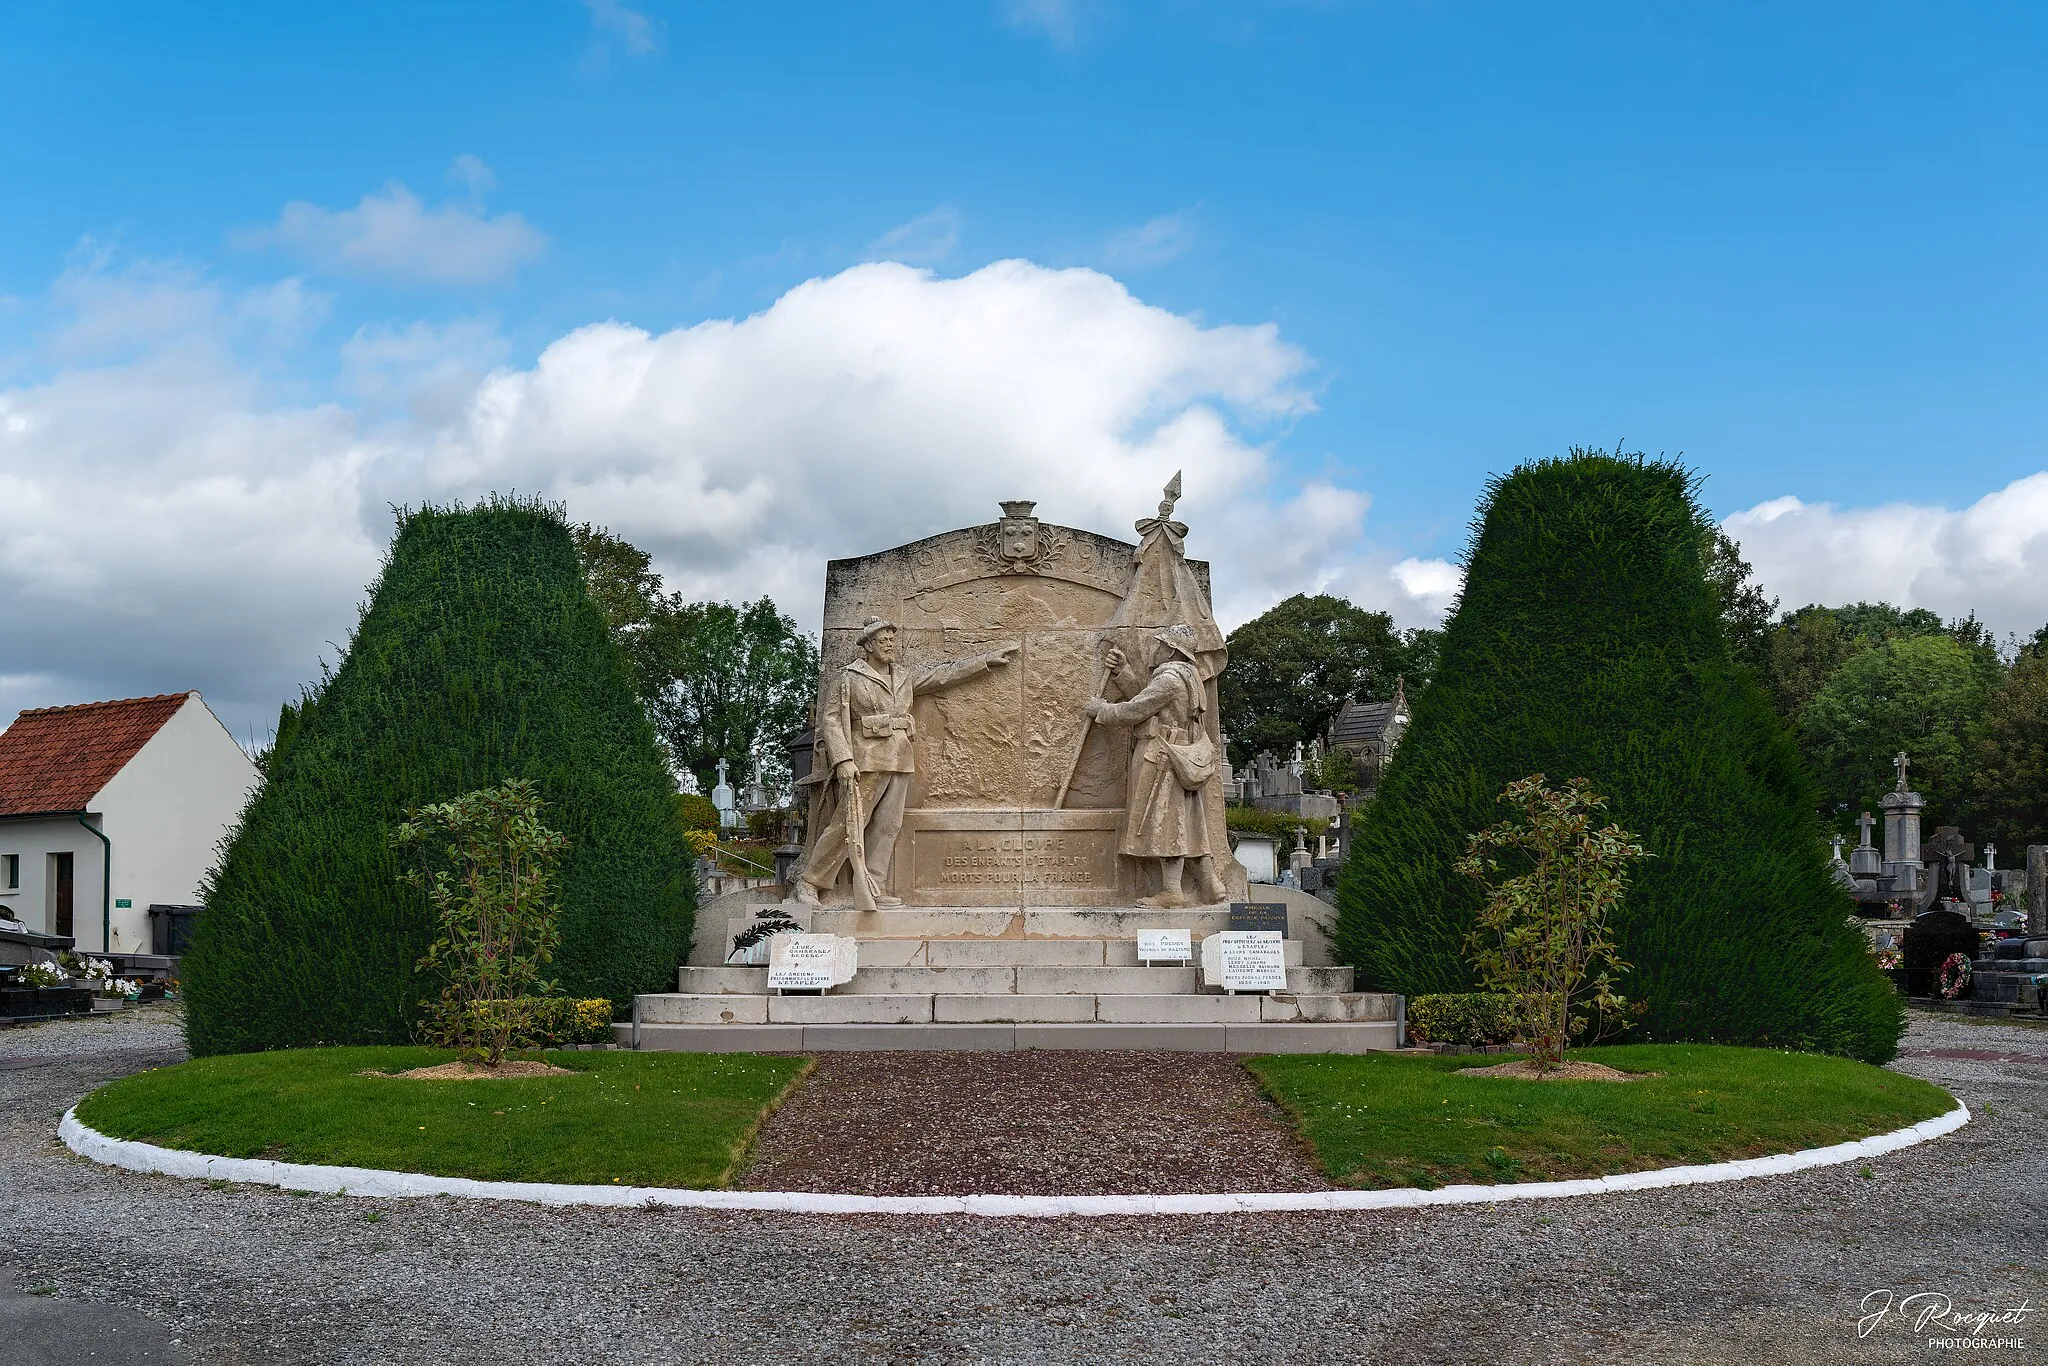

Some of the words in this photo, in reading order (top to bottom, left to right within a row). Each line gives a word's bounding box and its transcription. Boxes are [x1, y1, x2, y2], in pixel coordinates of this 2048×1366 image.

[977, 838, 997, 852] LA
[1001, 838, 1066, 852] GLOIRE
[946, 856, 968, 868] DES
[972, 856, 1022, 868] ENFANTS
[940, 872, 982, 884] MORTS
[986, 872, 1020, 884] POUR
[1024, 872, 1039, 884] LA
[1044, 872, 1092, 884] FRANCE
